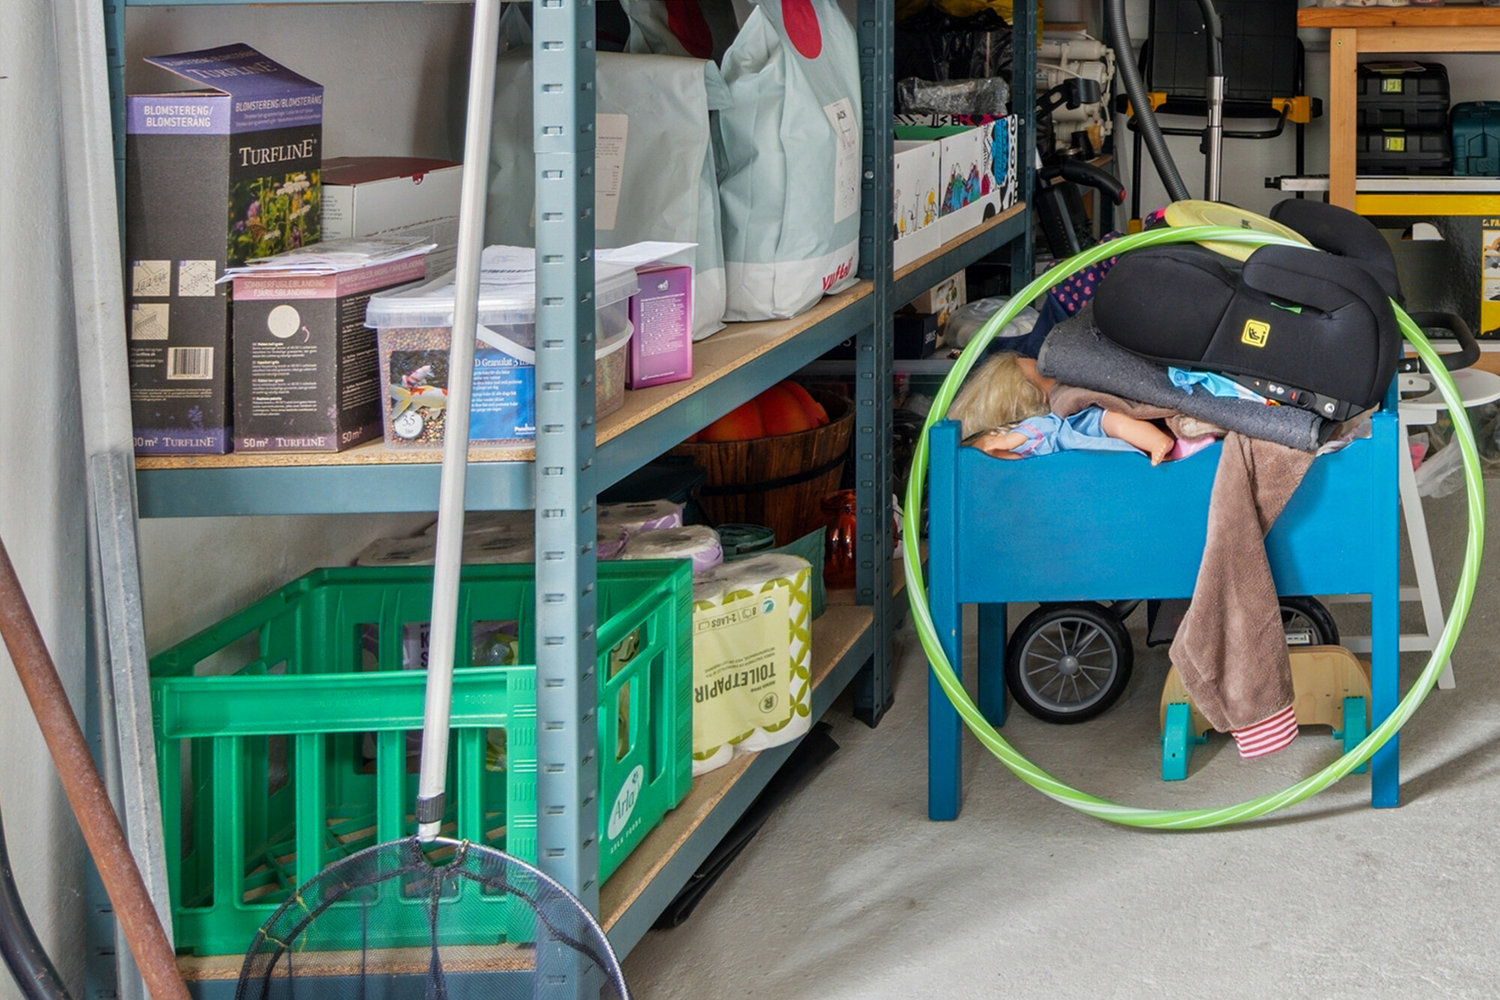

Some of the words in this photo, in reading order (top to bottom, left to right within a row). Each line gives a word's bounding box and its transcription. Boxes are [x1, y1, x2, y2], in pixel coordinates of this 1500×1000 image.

[143, 105, 214, 117] BLOMSTERENG/
[695, 661, 776, 704] TOILETPAPIR
[613, 789, 635, 825] Arla
